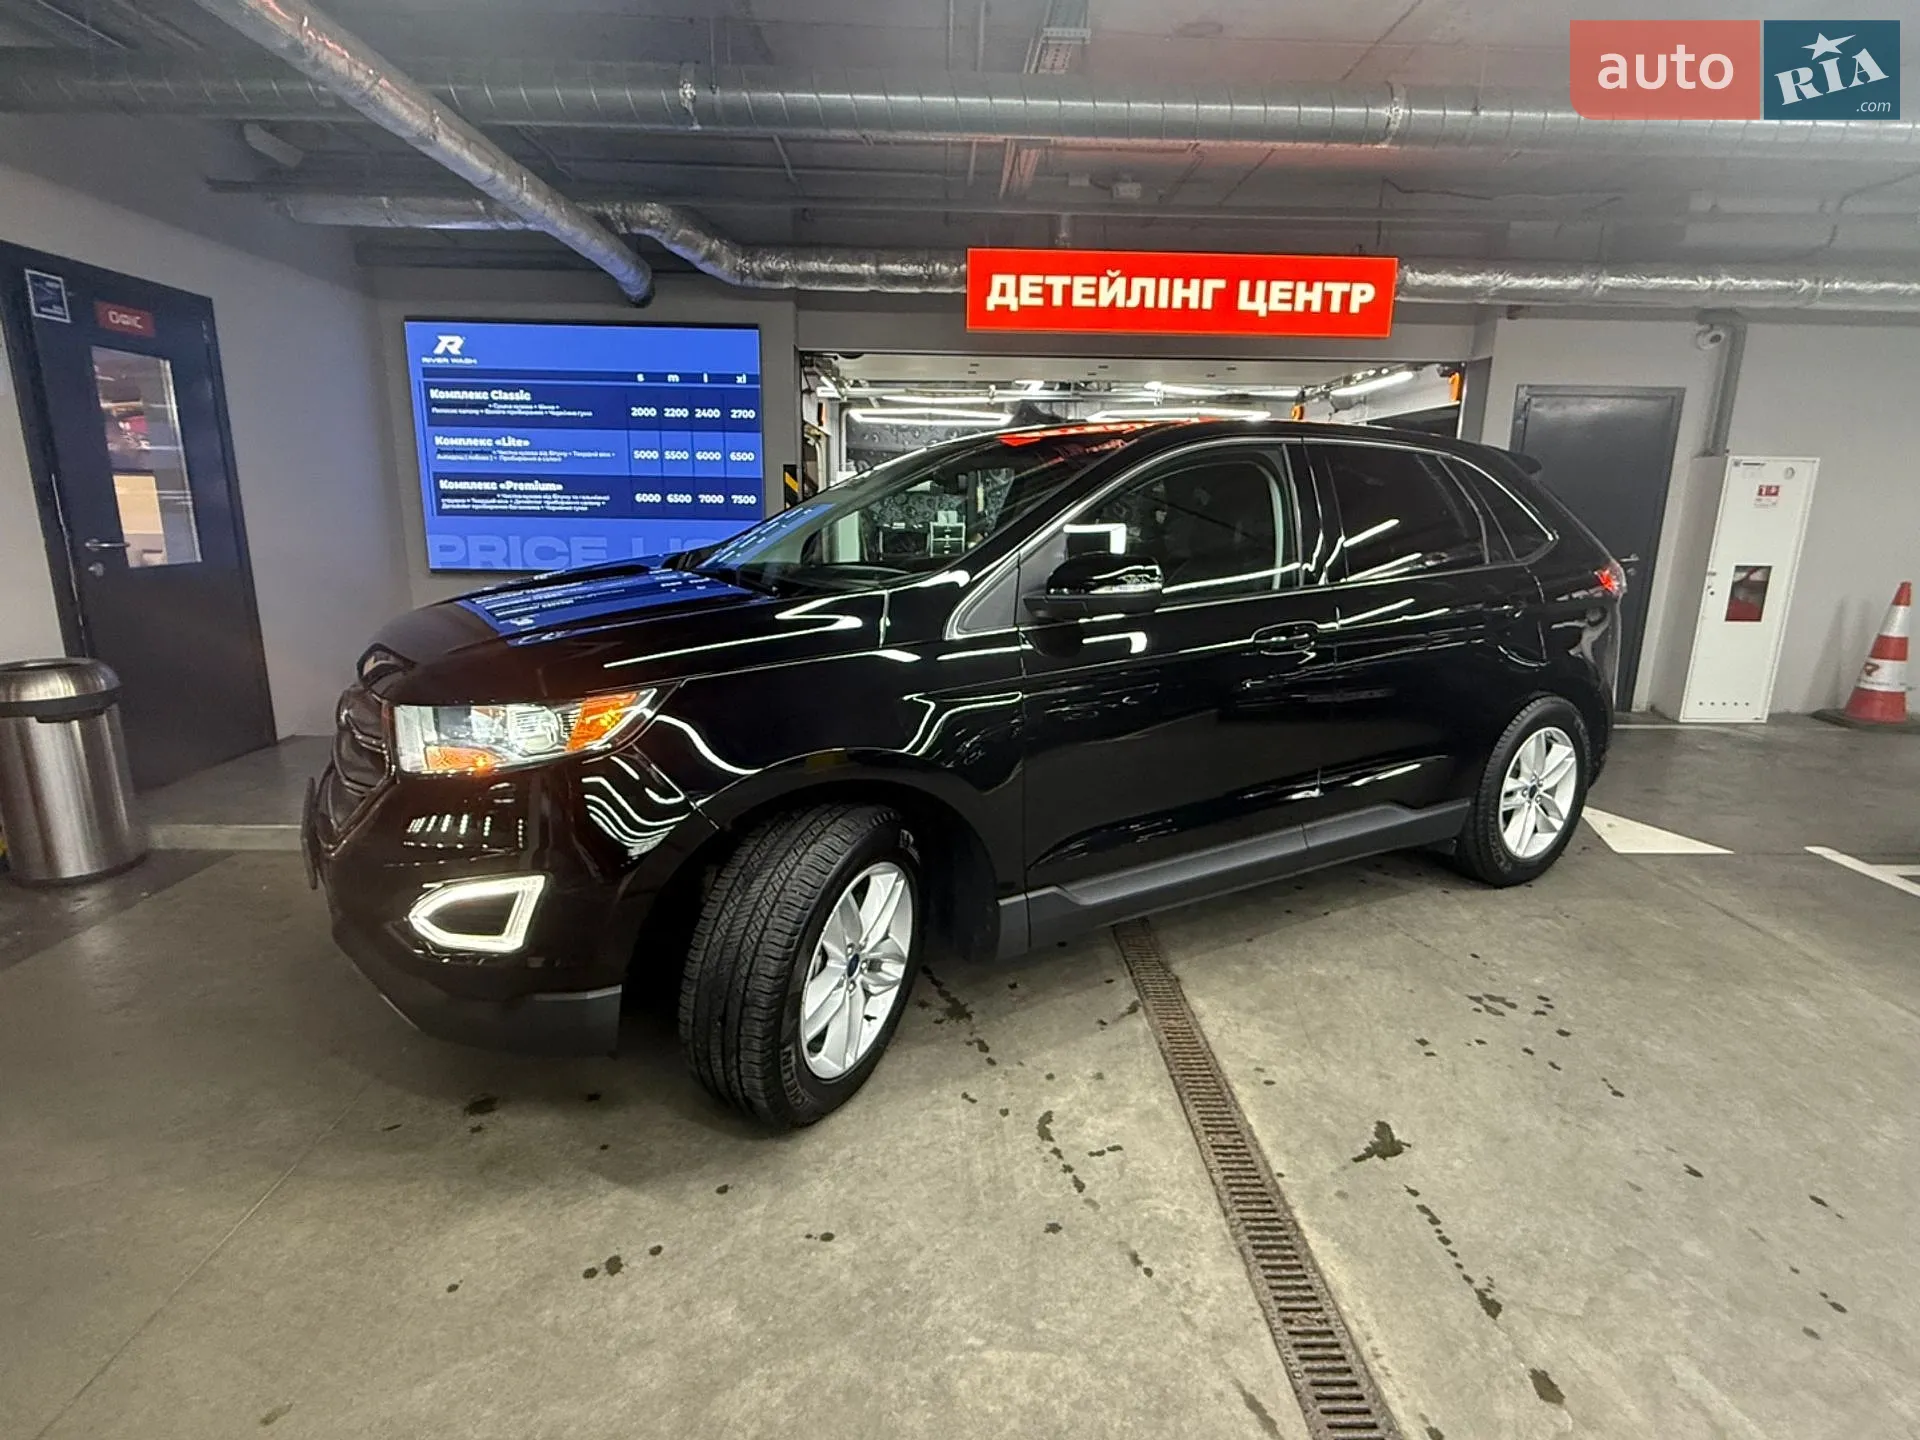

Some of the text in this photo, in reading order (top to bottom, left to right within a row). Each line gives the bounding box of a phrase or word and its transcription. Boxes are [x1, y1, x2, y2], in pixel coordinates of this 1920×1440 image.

[985, 269, 1377, 317] ДЕТЕЙЛІНГ ЦЕНТР
[637, 373, 645, 383] s
[667, 373, 680, 382] m
[736, 373, 747, 384] xl
[429, 388, 531, 401] Комплекс Classic
[630, 406, 658, 417] 2000
[663, 407, 690, 418] 2200
[694, 408, 721, 418] 2400
[730, 409, 756, 419] 2700
[434, 435, 530, 447] Комплекс «Lite»
[633, 450, 659, 460] 5000
[664, 450, 690, 460] 5500
[695, 451, 722, 461] 6000
[729, 452, 755, 461] 6500
[439, 479, 564, 491] Комплекс «Premium»
[635, 493, 662, 503] 6000
[666, 493, 692, 503] 6500
[697, 494, 725, 503] 7000
[731, 495, 757, 504] 7500
[428, 534, 608, 569] PRICE
